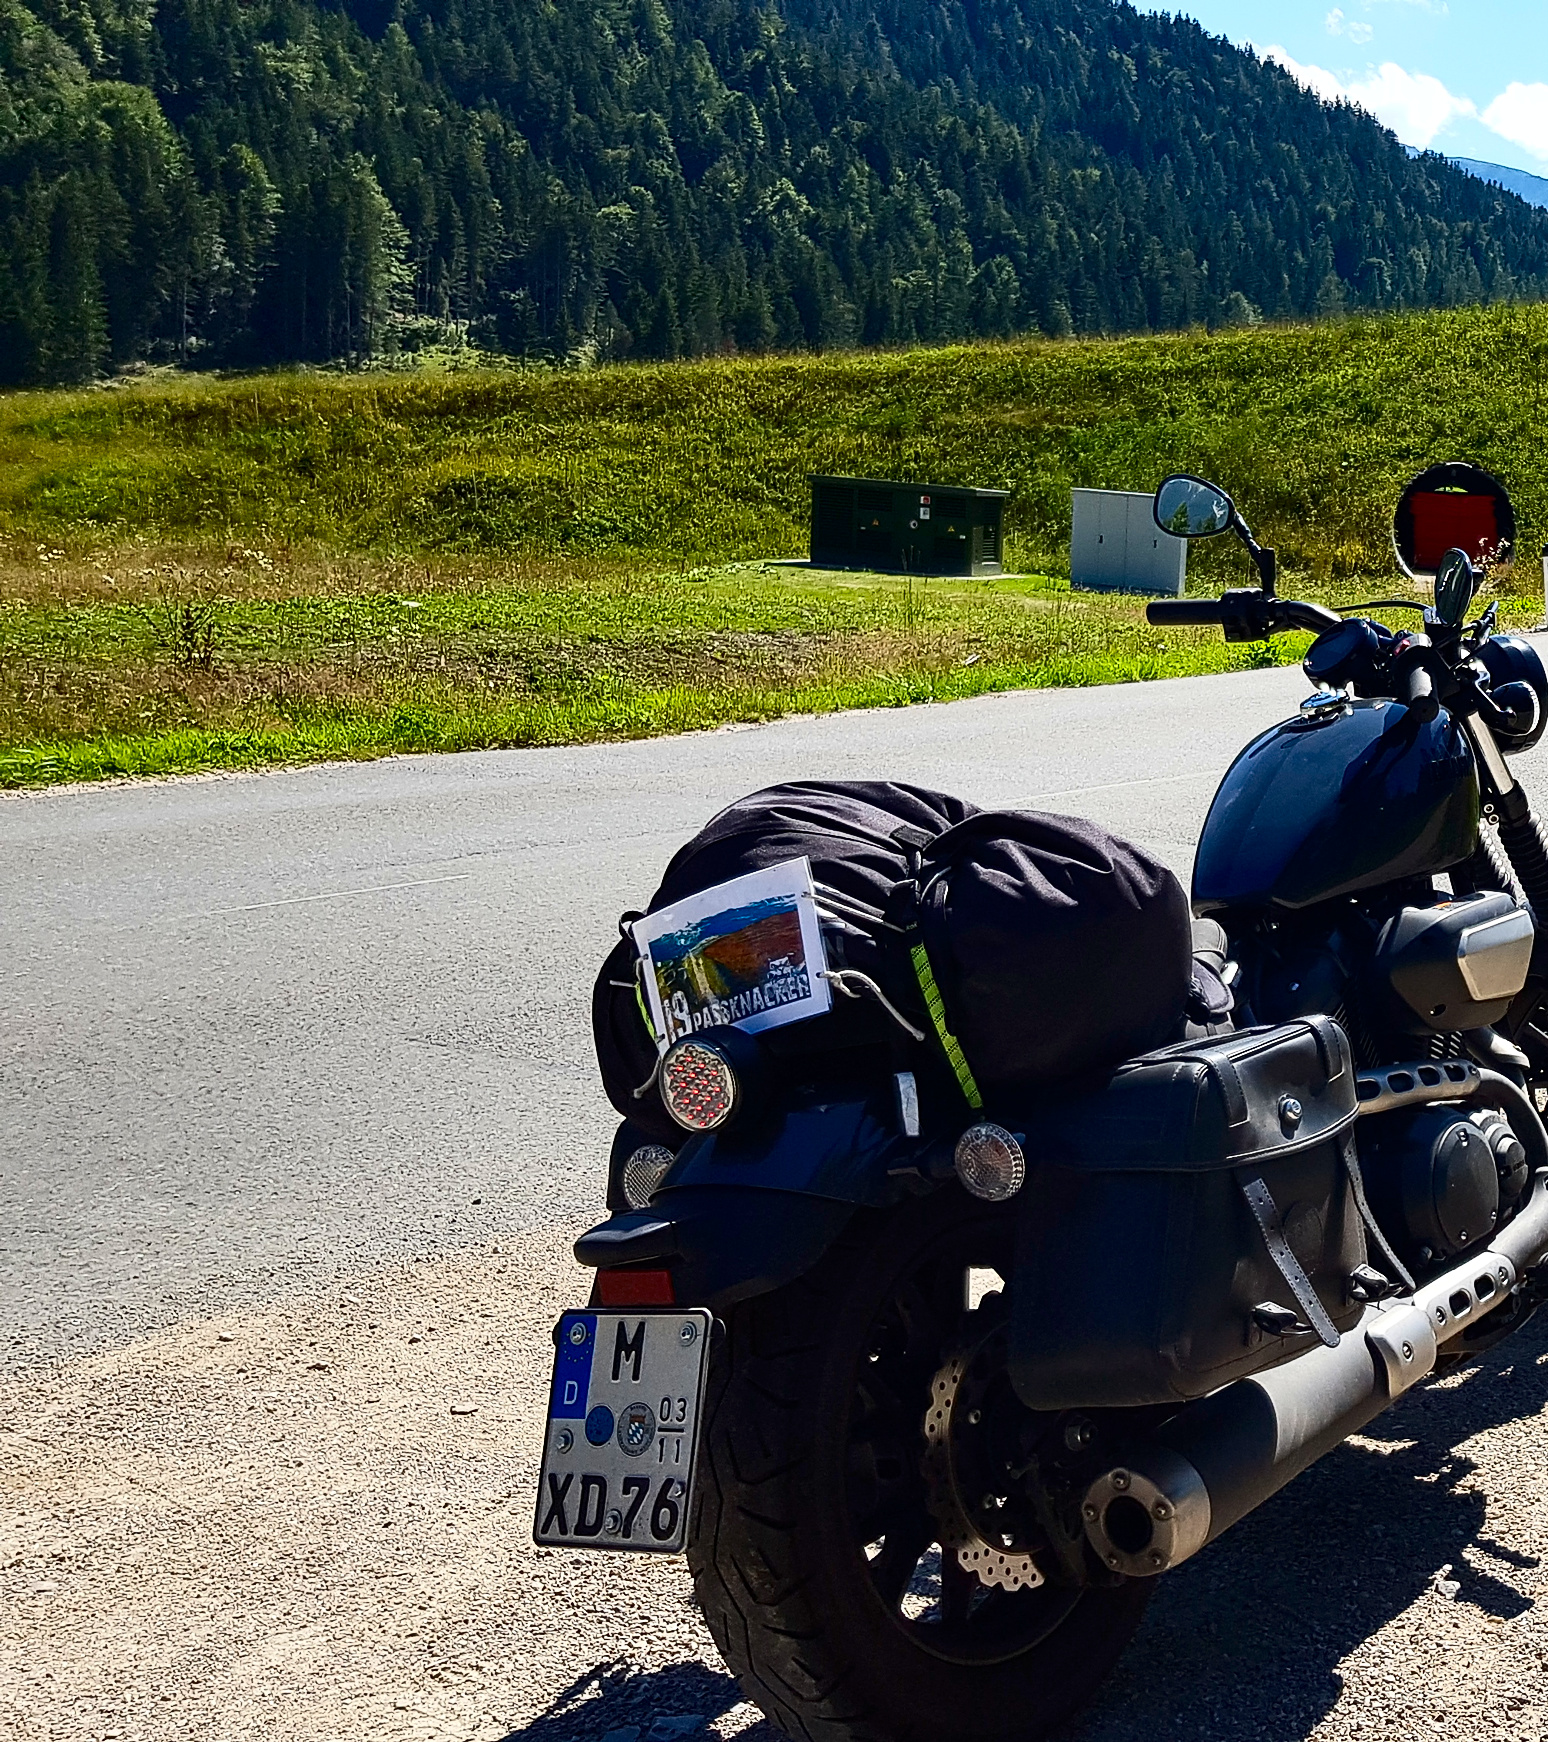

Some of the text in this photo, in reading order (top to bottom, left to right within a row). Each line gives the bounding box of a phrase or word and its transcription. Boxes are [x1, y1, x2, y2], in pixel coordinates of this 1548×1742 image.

[691, 973, 812, 1032] PASSKNACKER
[610, 1320, 647, 1382] M
[563, 1379, 579, 1405] D
[658, 1396, 688, 1423] 03
[658, 1437, 682, 1464] 11
[540, 1473, 680, 1541] XD 76
